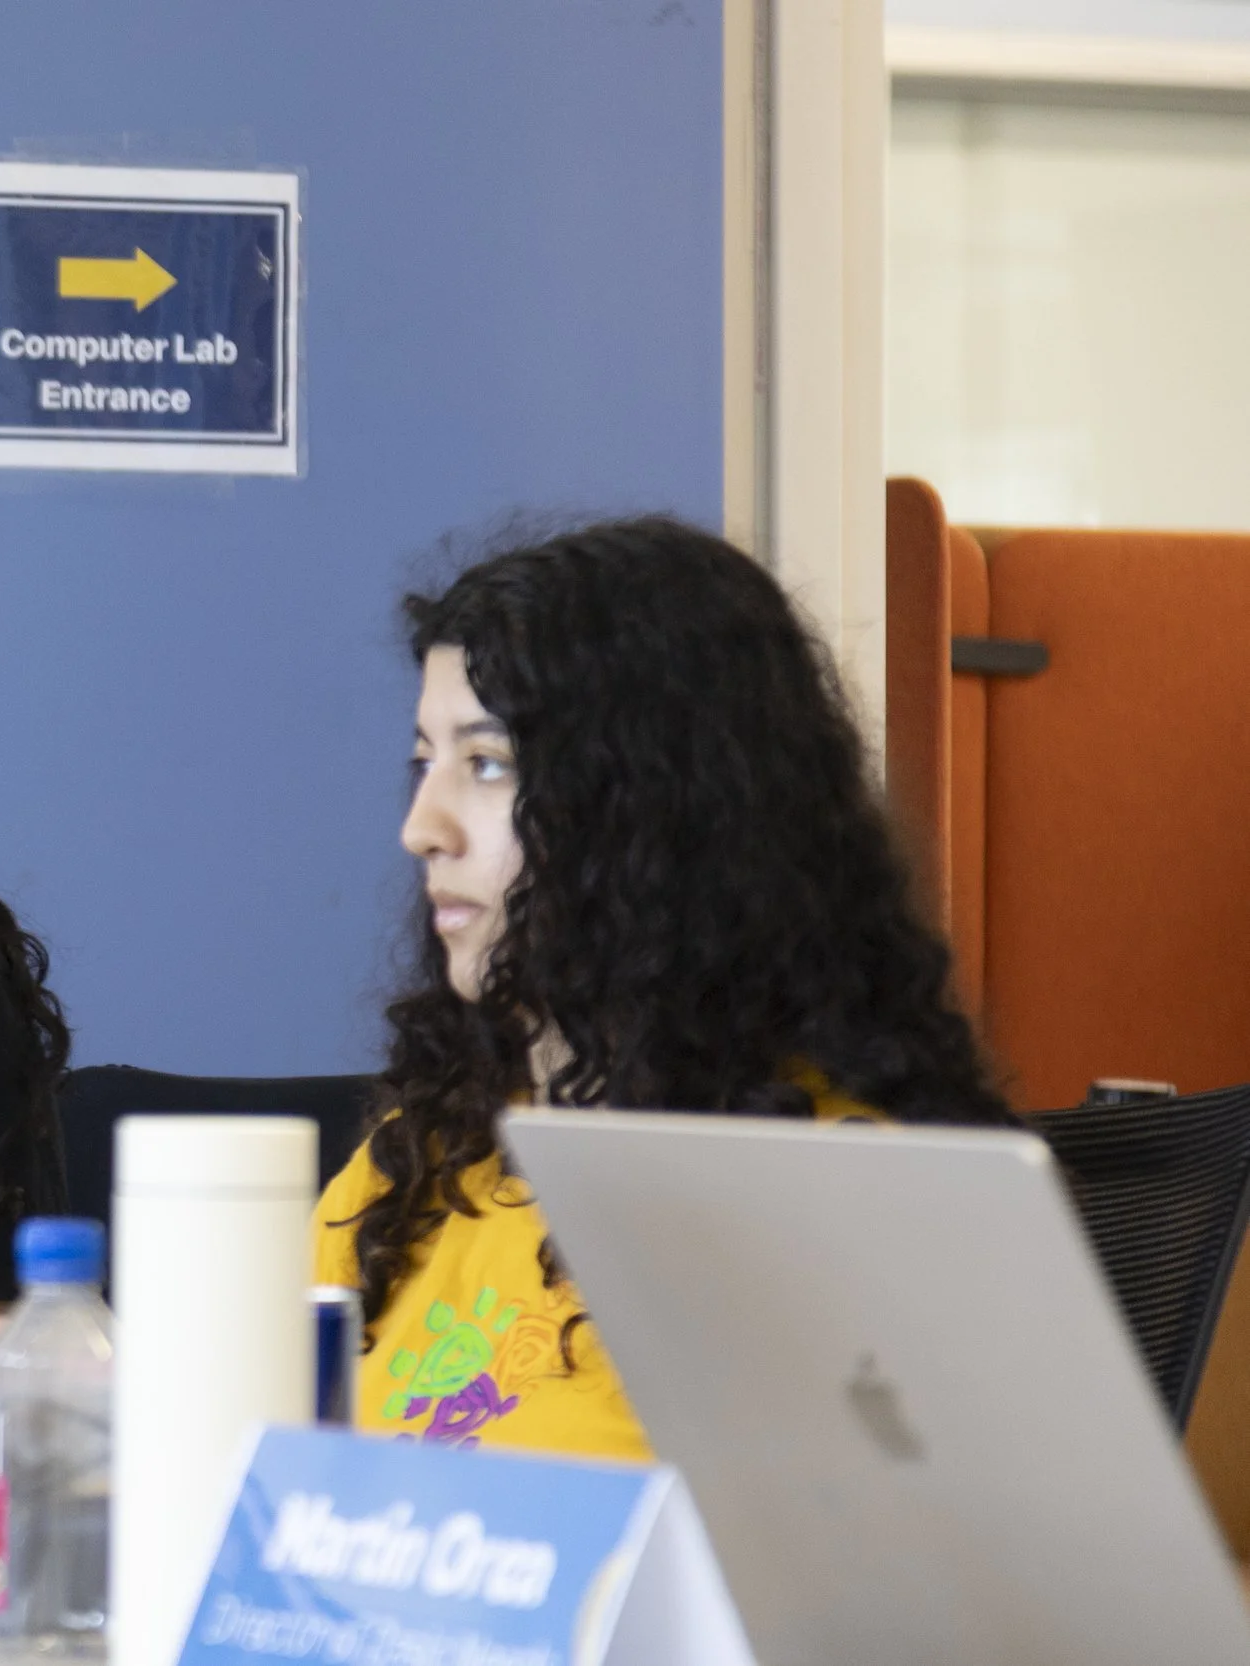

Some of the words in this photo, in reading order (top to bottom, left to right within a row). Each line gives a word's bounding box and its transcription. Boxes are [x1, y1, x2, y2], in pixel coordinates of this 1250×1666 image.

[0, 329, 169, 367] Computer
[174, 332, 238, 365] Lab
[39, 379, 192, 413] Entrance
